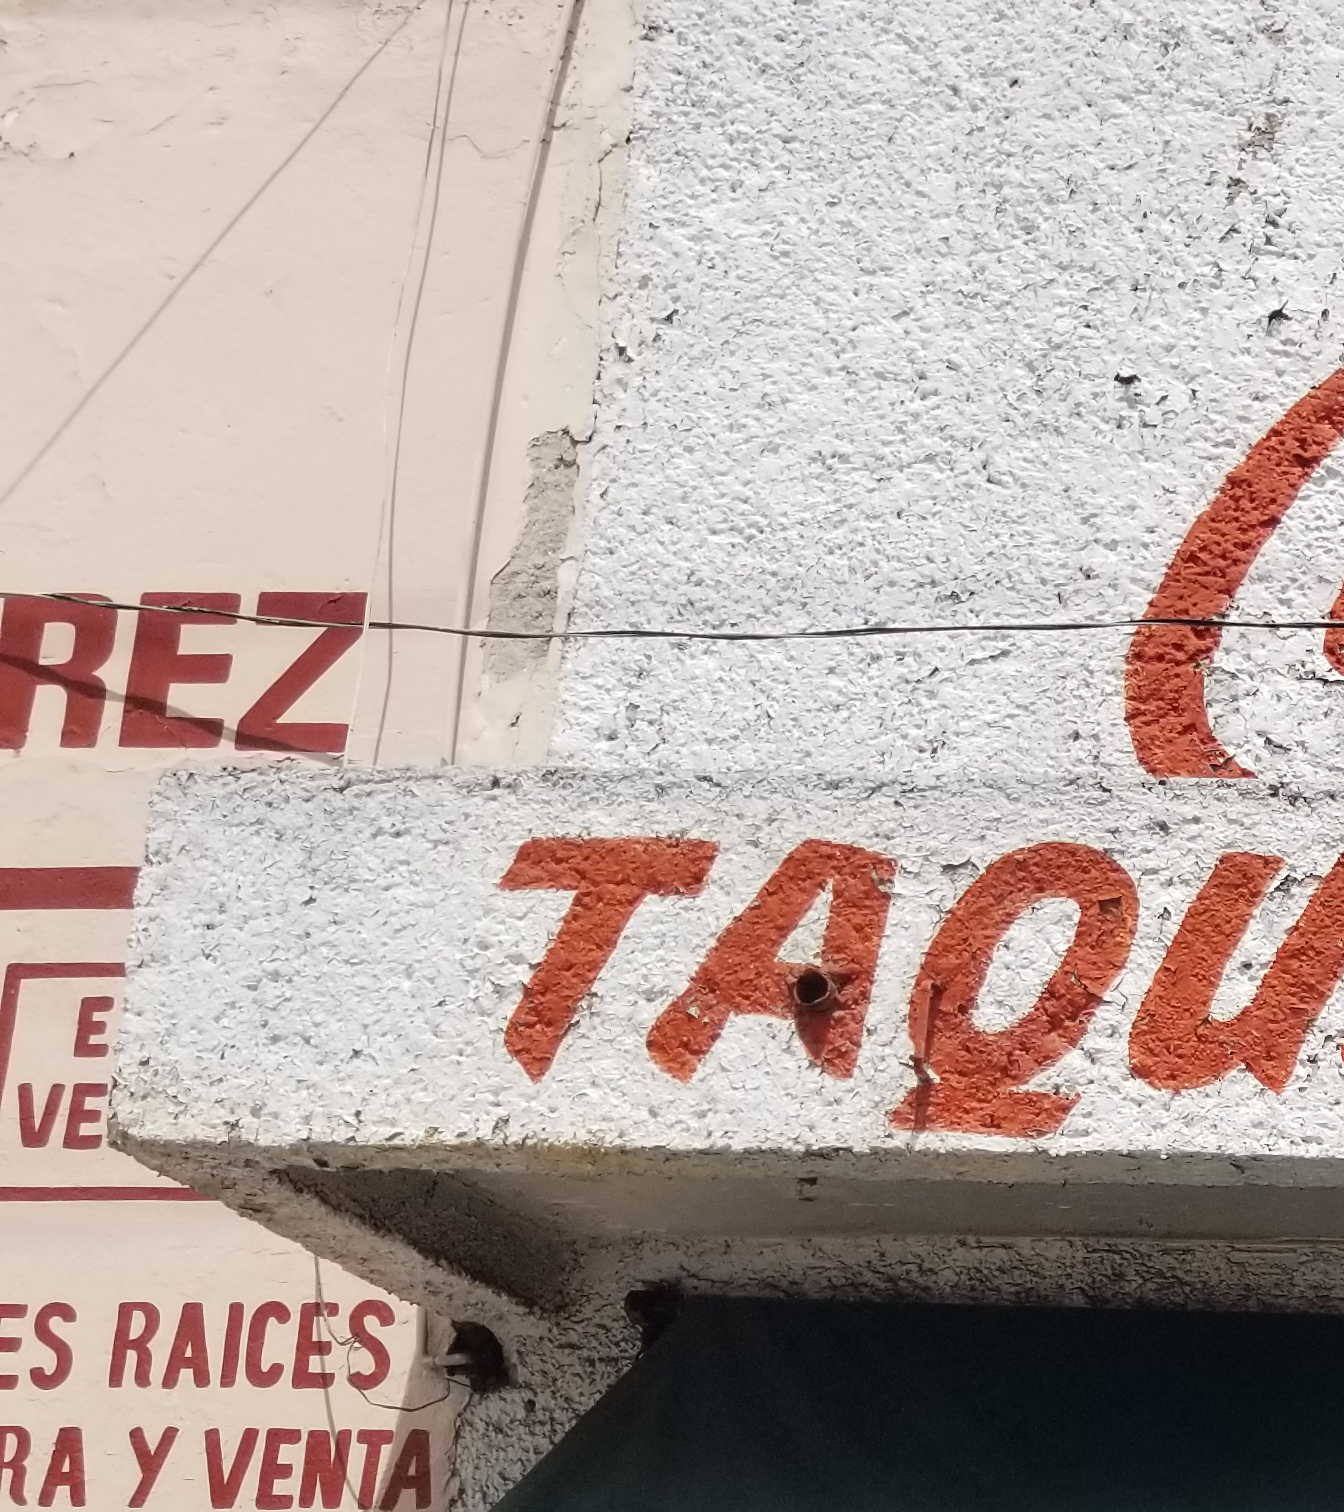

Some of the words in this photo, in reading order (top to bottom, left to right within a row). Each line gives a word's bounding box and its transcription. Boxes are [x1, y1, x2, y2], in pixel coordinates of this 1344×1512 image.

[0, 591, 368, 753] REZ
[108, 1300, 396, 1390] RAICES
[128, 1426, 180, 1508] Y
[204, 1427, 432, 1512] VENTA
